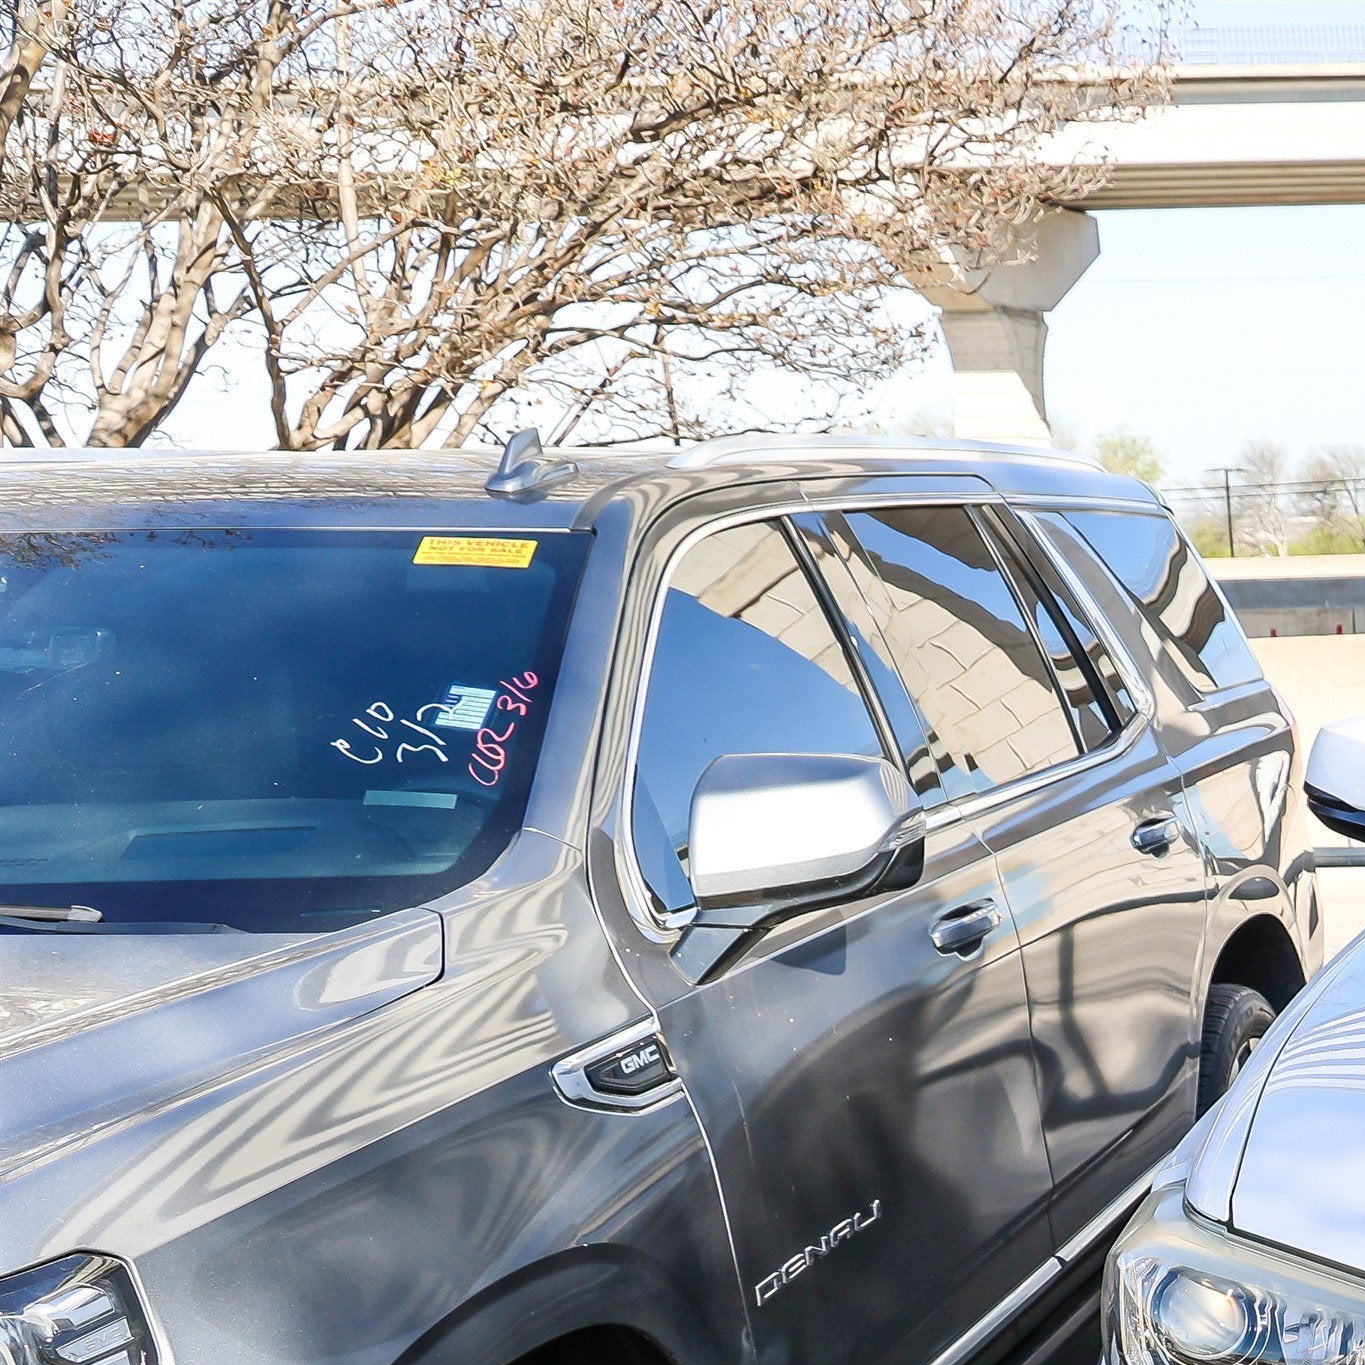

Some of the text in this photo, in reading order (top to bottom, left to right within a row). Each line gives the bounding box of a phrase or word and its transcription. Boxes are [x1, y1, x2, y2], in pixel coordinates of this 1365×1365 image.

[466, 540, 529, 549] VEHICLE
[489, 547, 524, 555] SALE
[620, 1044, 661, 1074] GMC
[755, 1199, 881, 1306] DENALI
